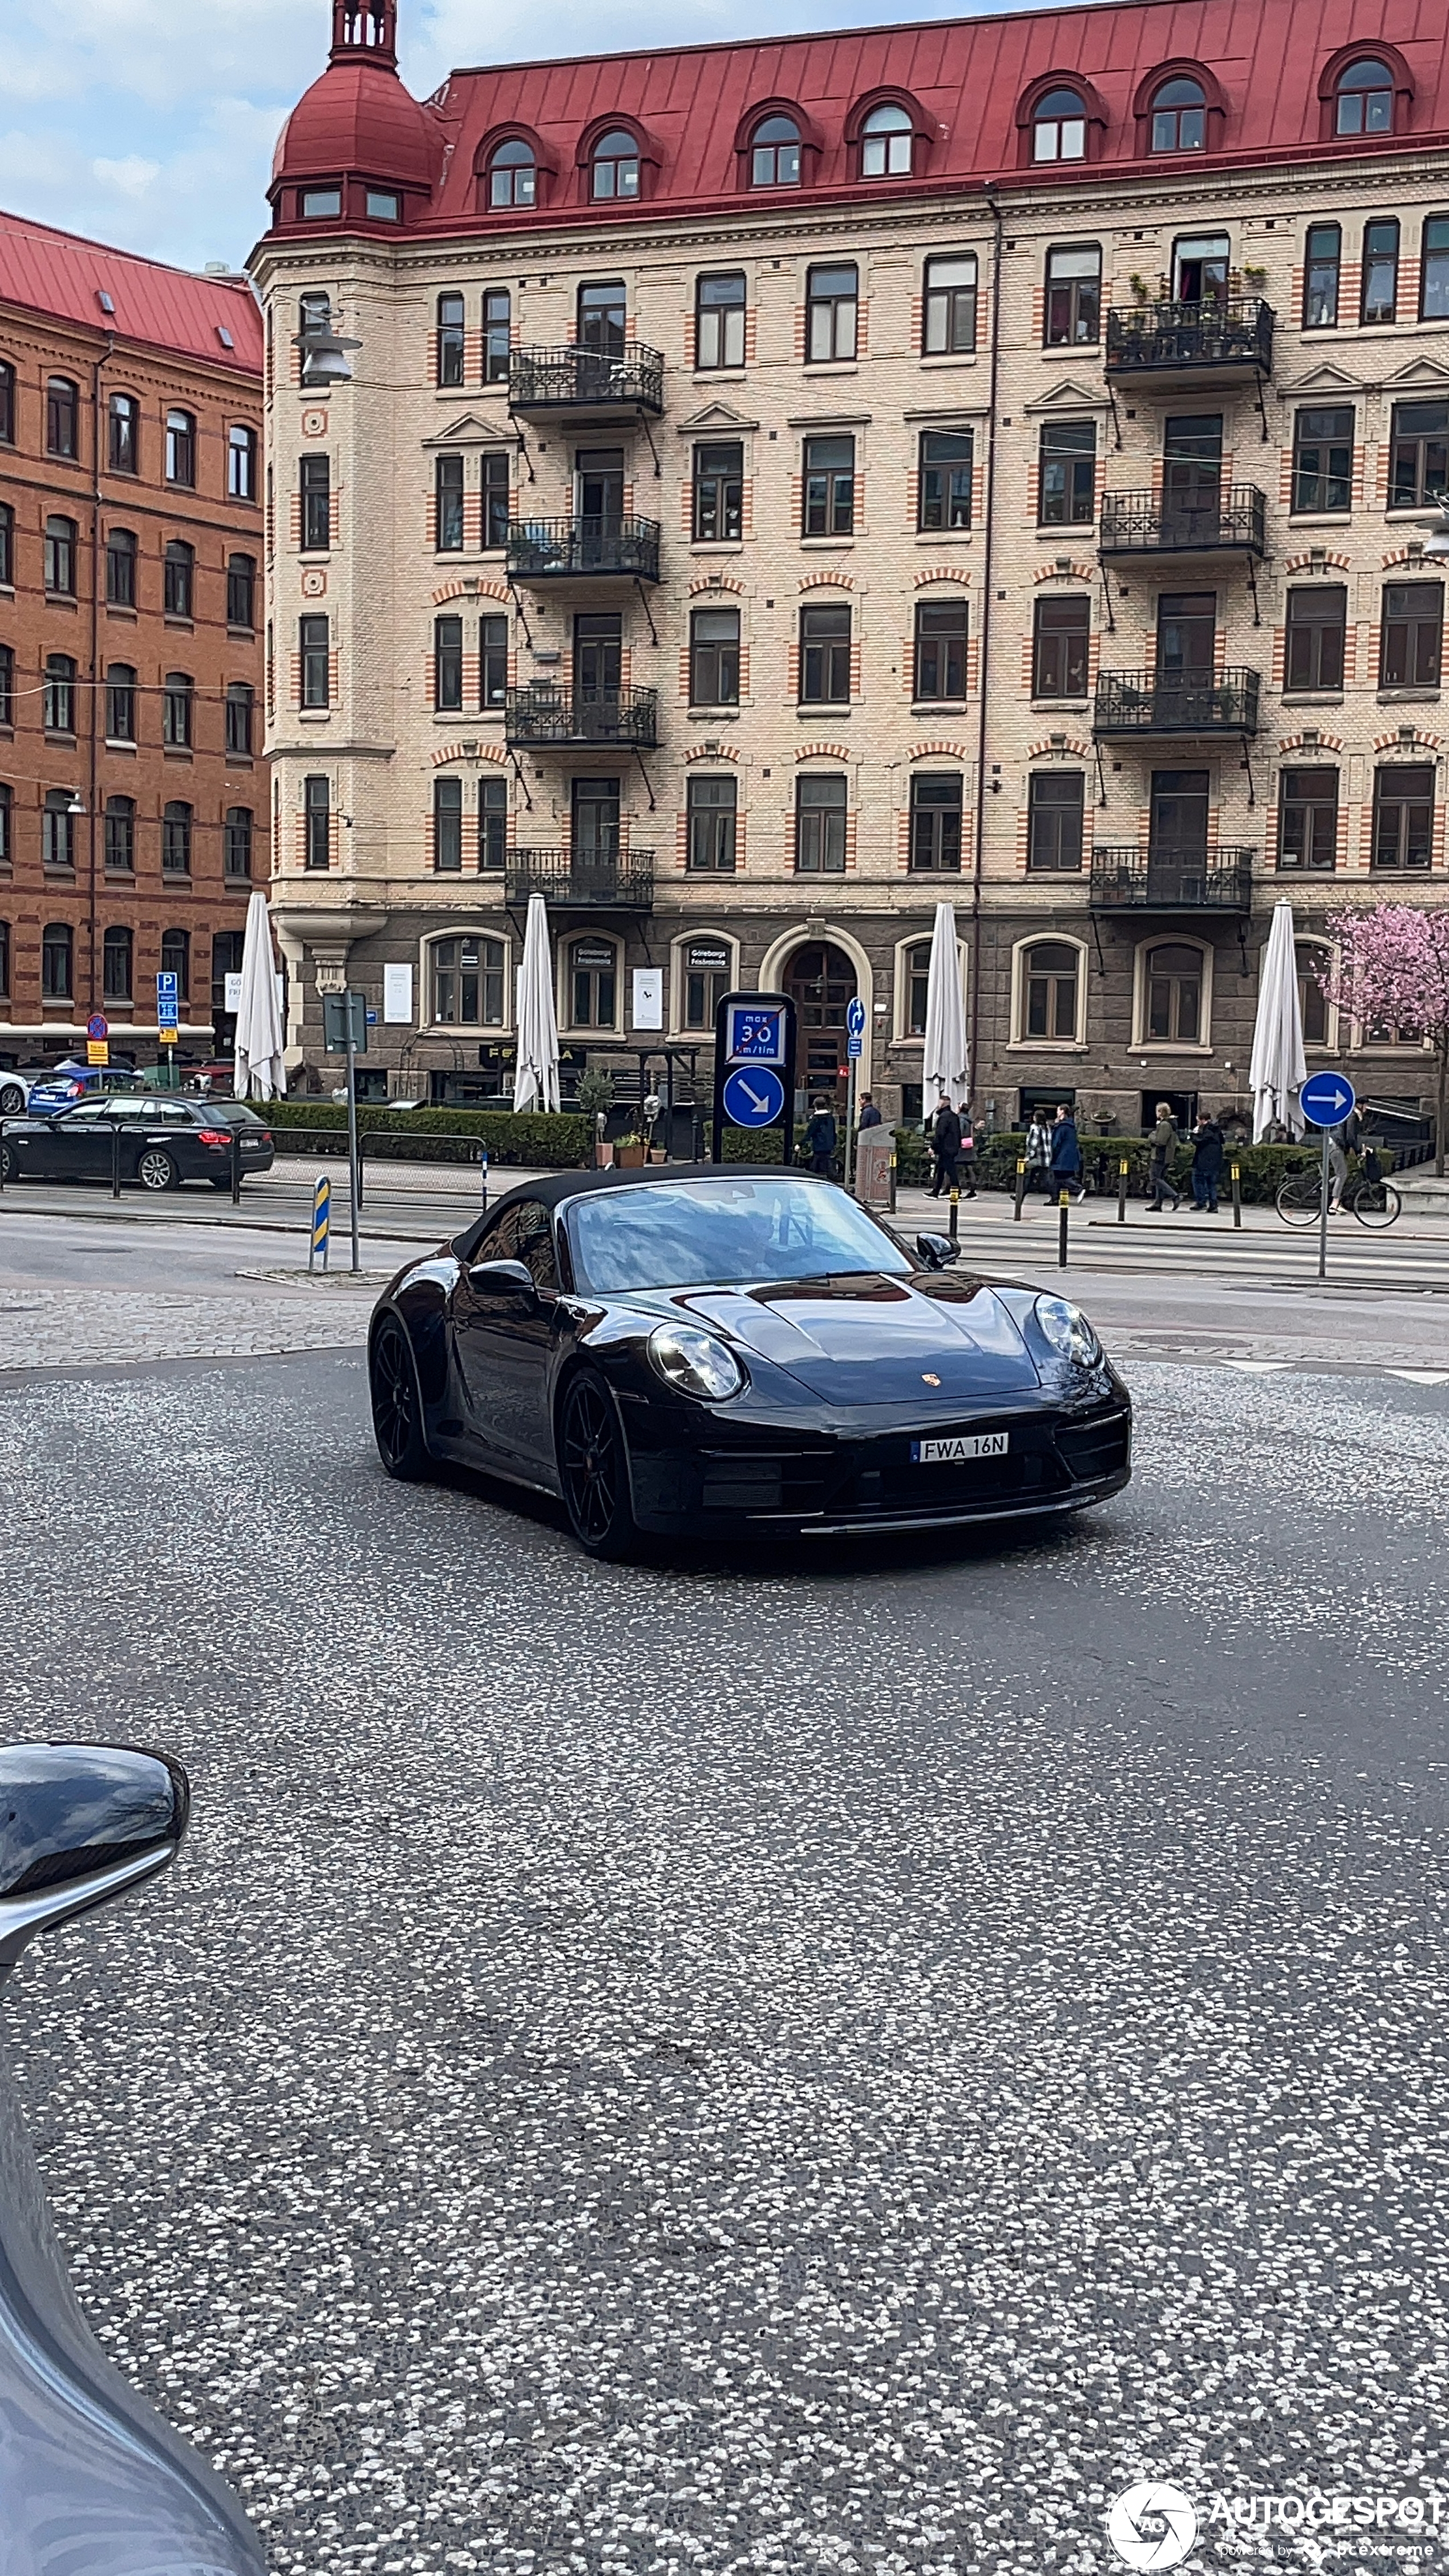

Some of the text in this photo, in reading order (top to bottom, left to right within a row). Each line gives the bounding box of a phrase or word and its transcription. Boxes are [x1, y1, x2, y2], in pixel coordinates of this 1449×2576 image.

[163, 975, 172, 991] P
[741, 1026, 771, 1043] 30
[925, 1435, 1004, 1460] FWA 16N
